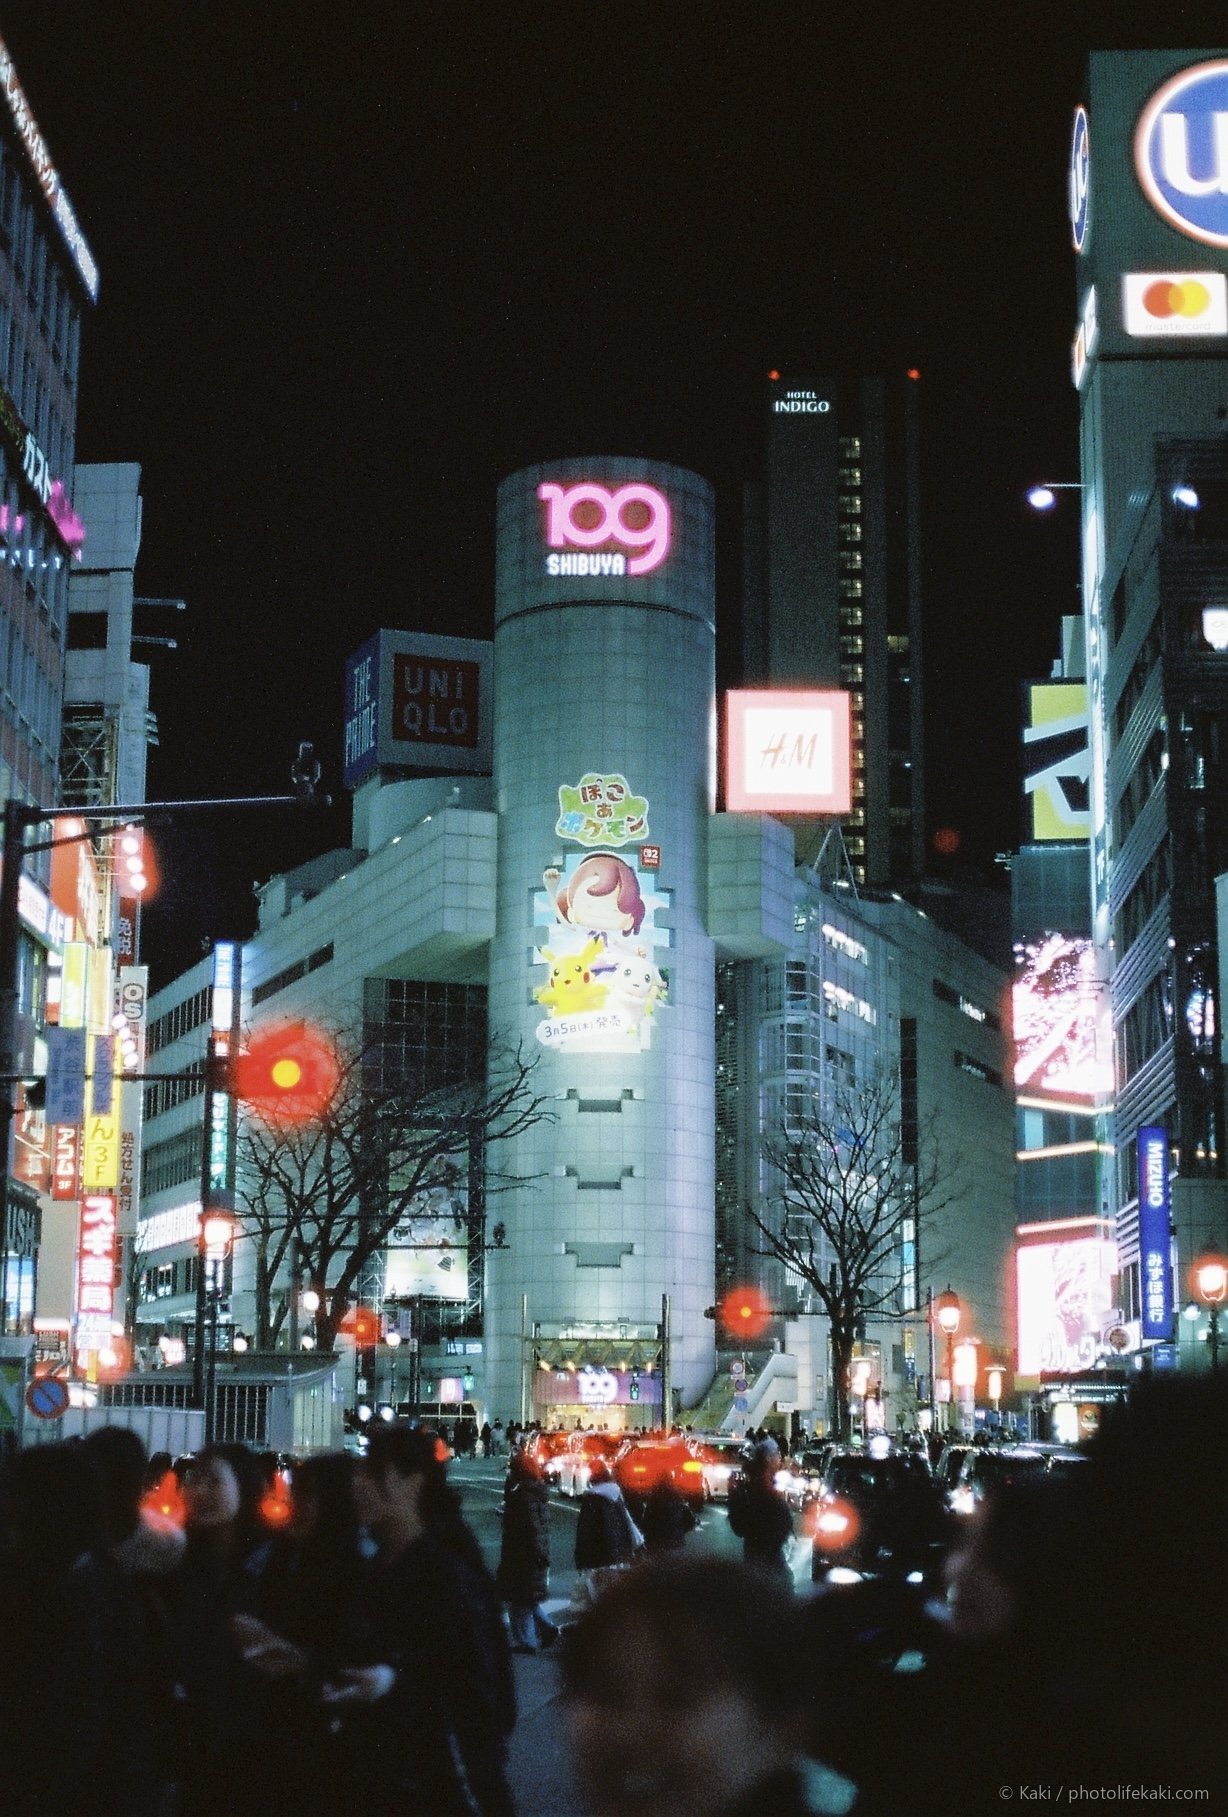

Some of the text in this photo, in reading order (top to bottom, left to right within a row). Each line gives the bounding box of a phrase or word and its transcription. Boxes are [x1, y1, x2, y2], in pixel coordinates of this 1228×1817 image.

[774, 401, 830, 413] INDIGO
[787, 391, 817, 399] HOTEL
[540, 482, 672, 575] 109
[546, 553, 627, 576] SHIBUYA
[403, 701, 468, 736] QLO
[760, 732, 819, 770] H&M
[123, 982, 145, 1020] OS
[57, 1127, 76, 1175] アコム
[58, 1180, 73, 1190] 3F
[1148, 1142, 1164, 1208] MIZUHO
[1148, 1254, 1164, 1323] みずほ銀行
